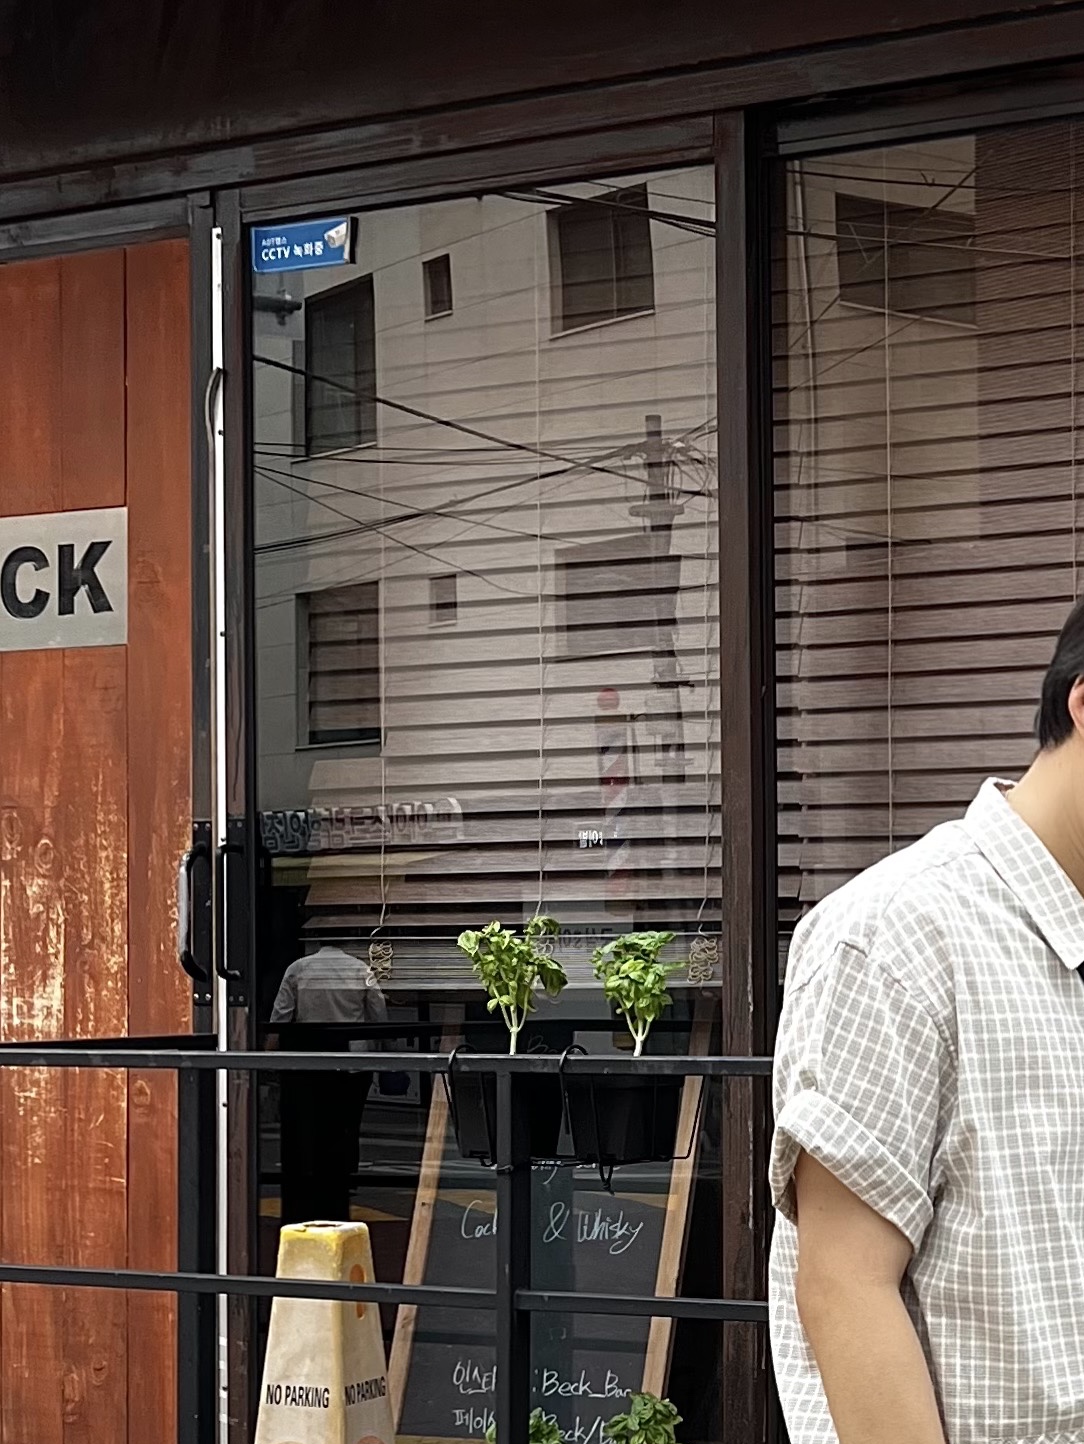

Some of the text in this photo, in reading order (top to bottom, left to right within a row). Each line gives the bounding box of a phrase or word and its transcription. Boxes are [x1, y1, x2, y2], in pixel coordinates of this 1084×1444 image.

[261, 241, 324, 261] CCTV 녹화중
[1, 540, 114, 619] CK
[542, 1201, 571, 1242] &
[576, 1207, 644, 1255] Whisky
[265, 1384, 330, 1409] NO PARKING
[344, 1375, 387, 1407] NO PARKING
